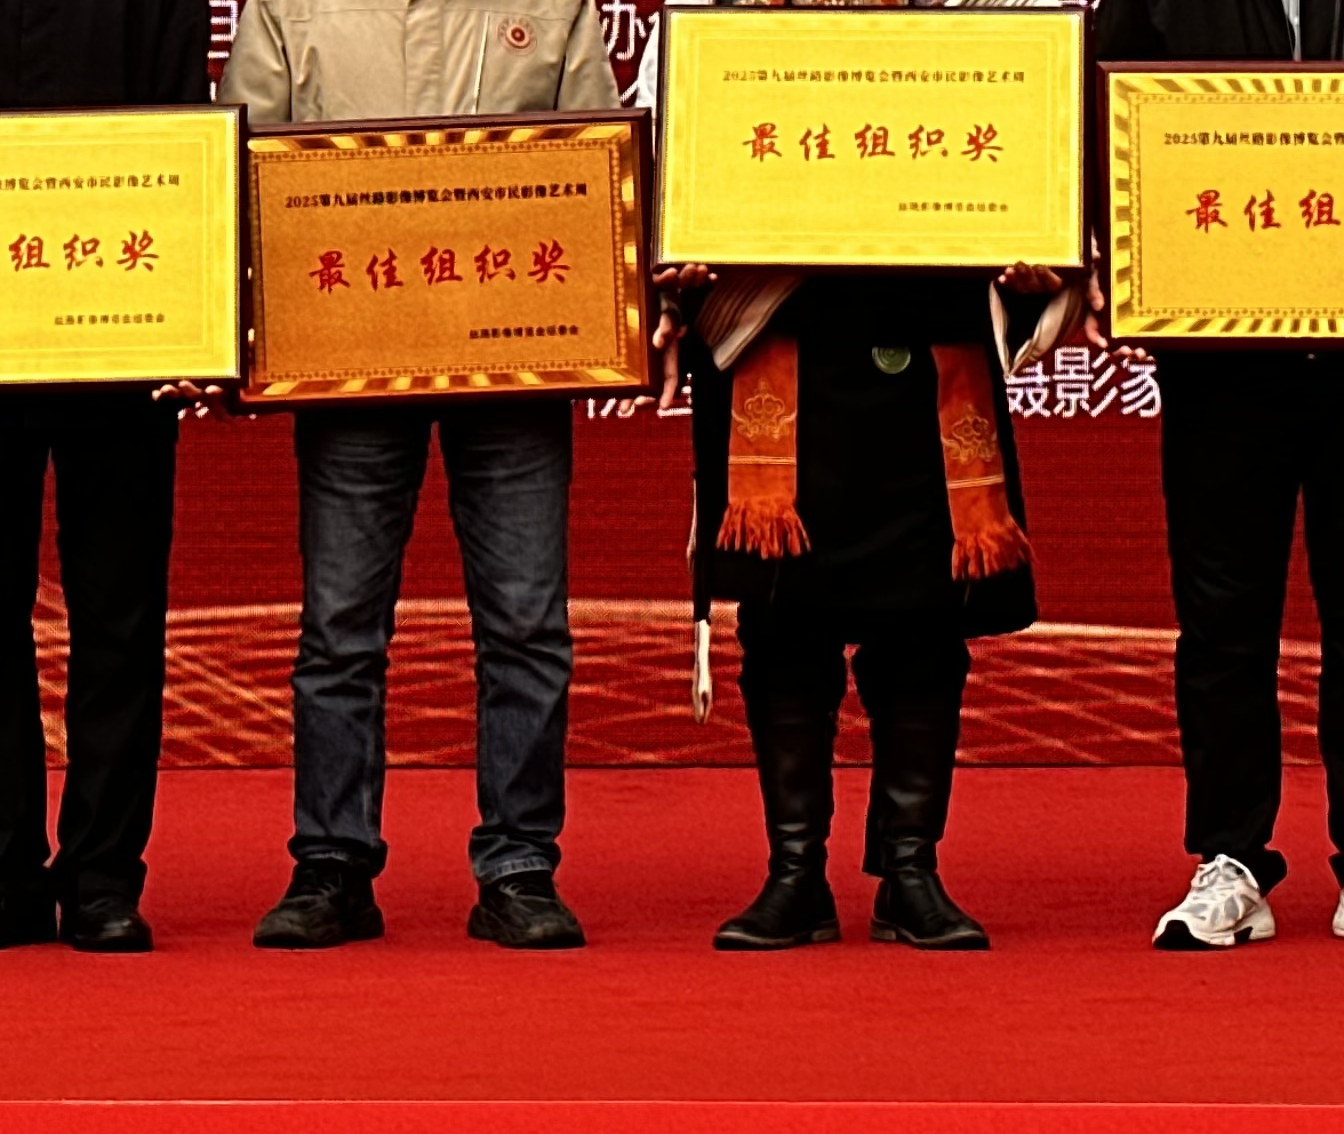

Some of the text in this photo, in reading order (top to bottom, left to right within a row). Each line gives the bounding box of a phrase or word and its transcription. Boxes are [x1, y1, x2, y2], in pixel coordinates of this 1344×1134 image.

[743, 122, 1004, 162] 最佳组织奖
[309, 239, 571, 294] 最佳组织奖
